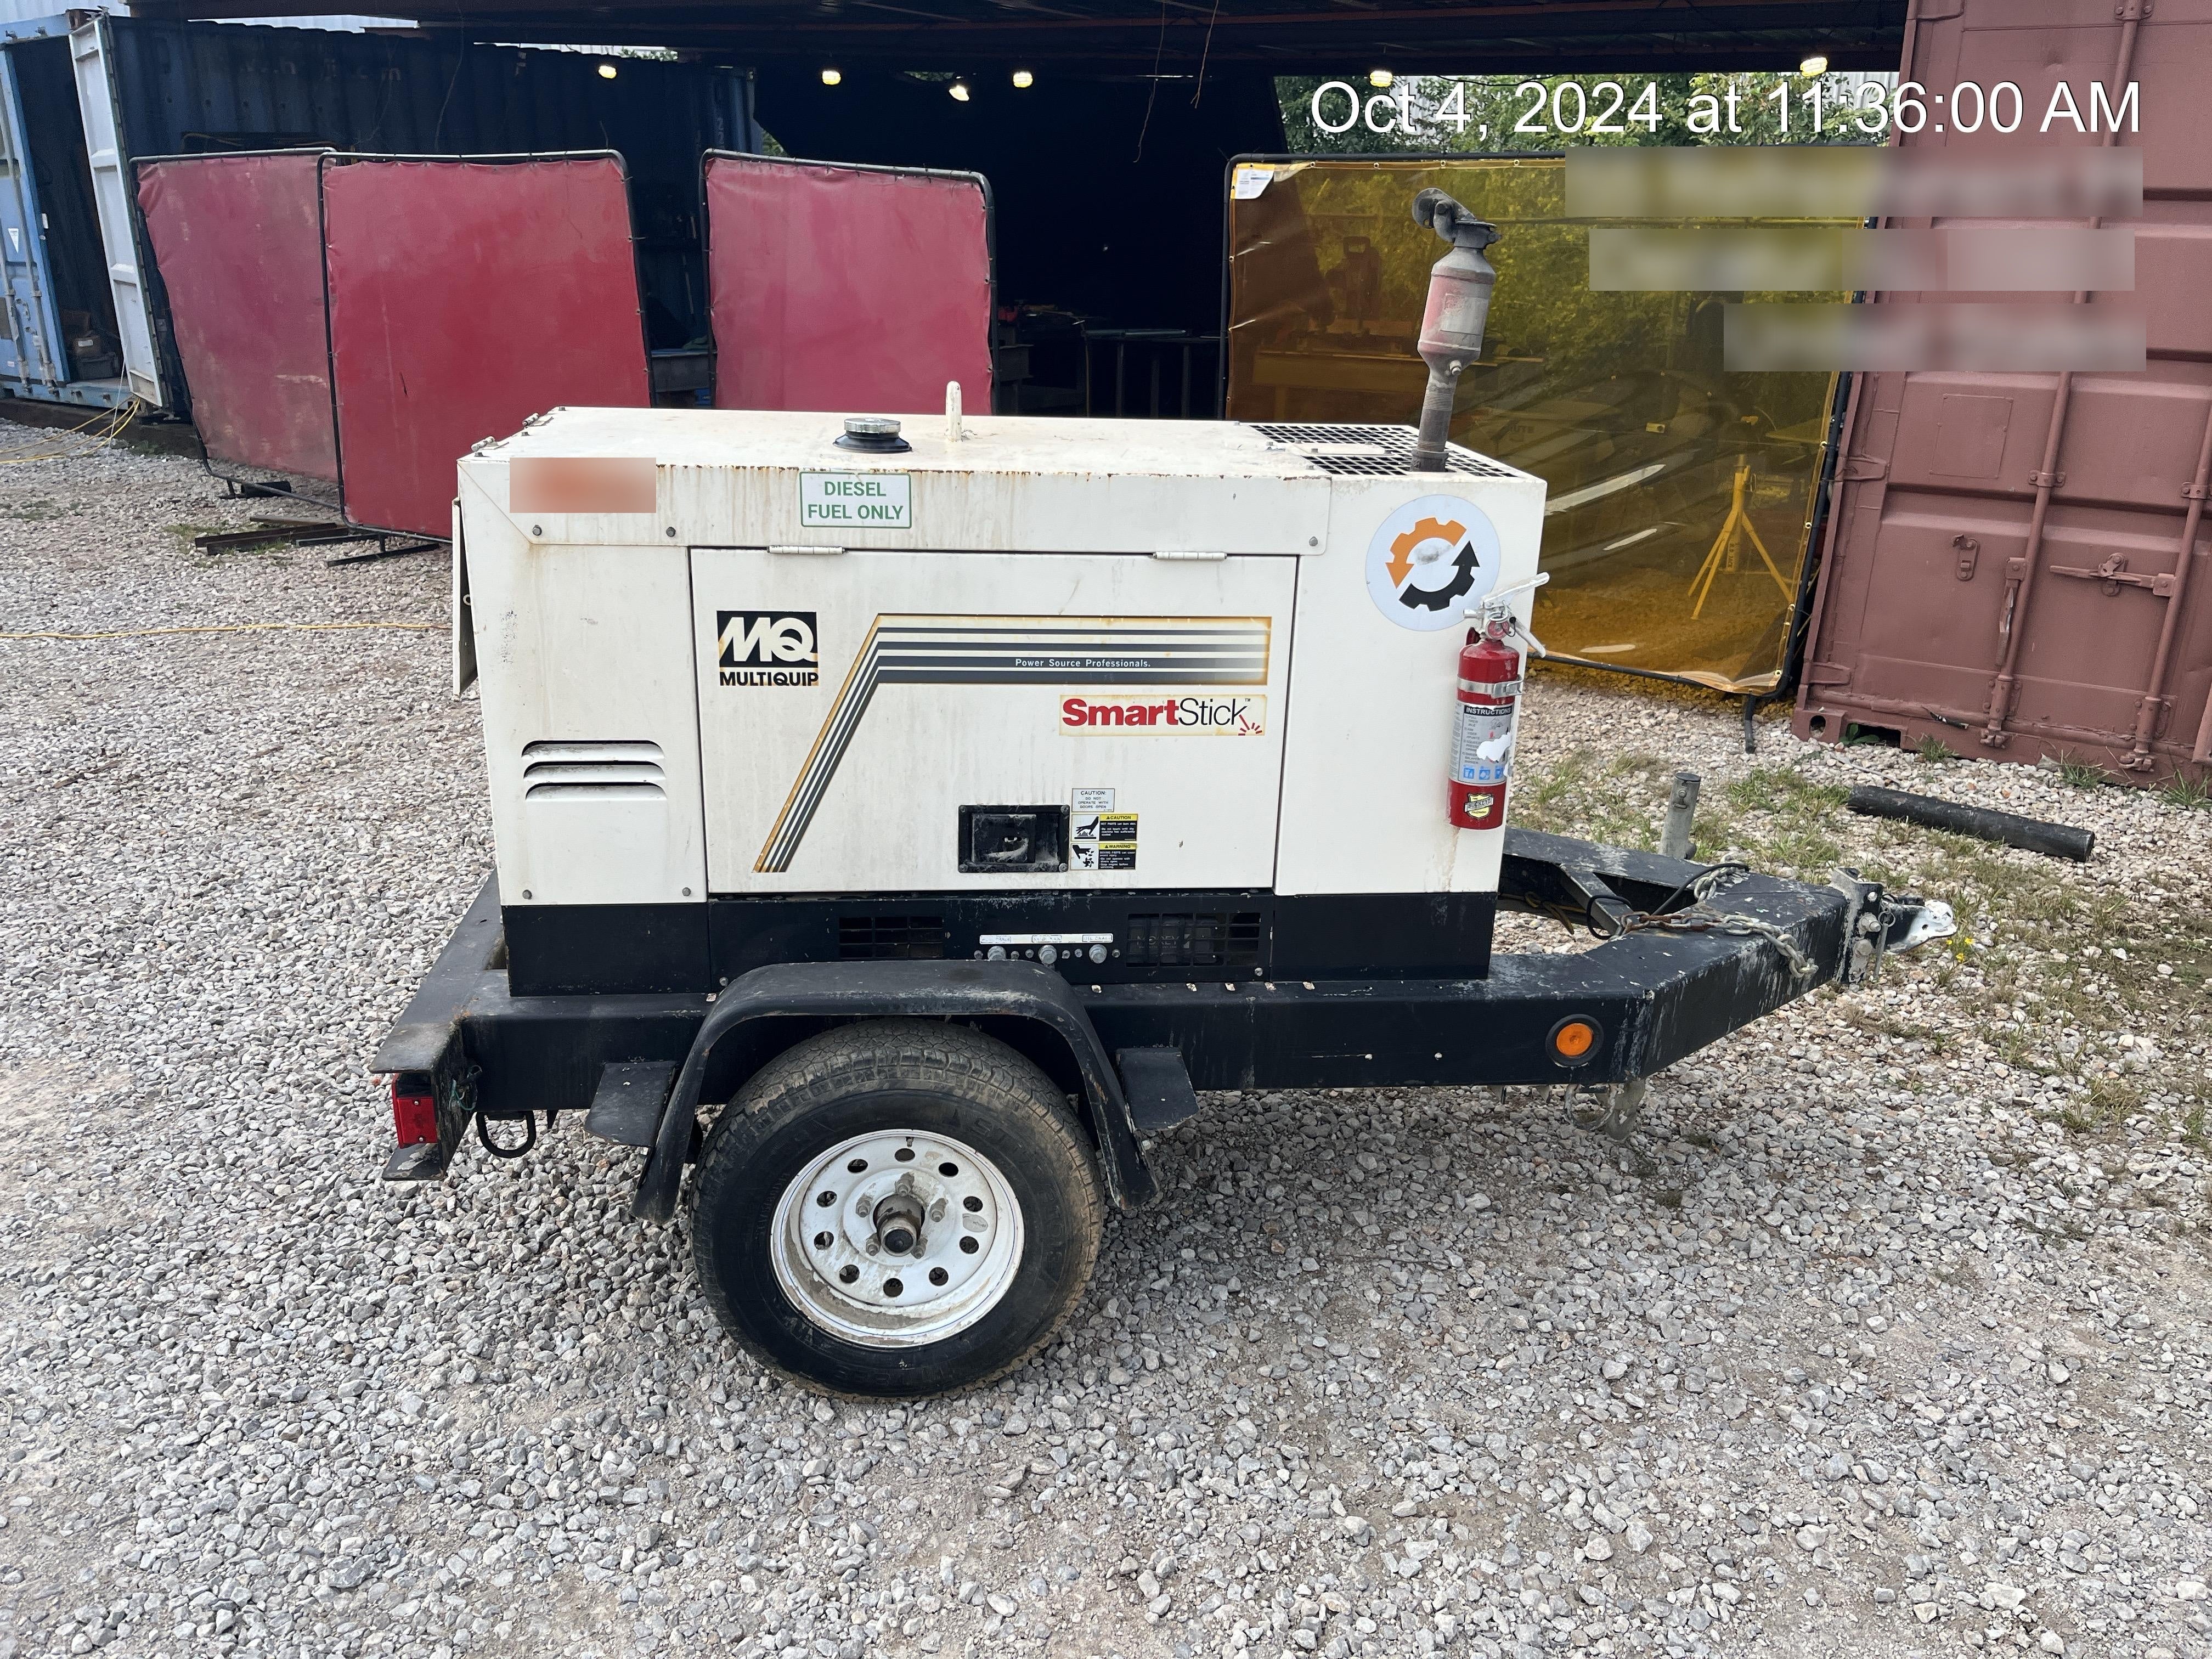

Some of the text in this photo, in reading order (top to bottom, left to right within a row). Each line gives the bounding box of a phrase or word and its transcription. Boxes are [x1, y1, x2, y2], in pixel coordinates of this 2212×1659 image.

[824, 481, 887, 496] DIESEL
[808, 504, 904, 520] FUEL ONLY
[719, 617, 818, 662] MQ
[1015, 658, 1151, 667] Power Source Professionals.
[719, 672, 819, 686] MULTIQUIP
[1062, 698, 1248, 726] SmartStick
[1466, 707, 1511, 715] INSTRUCTIONS
